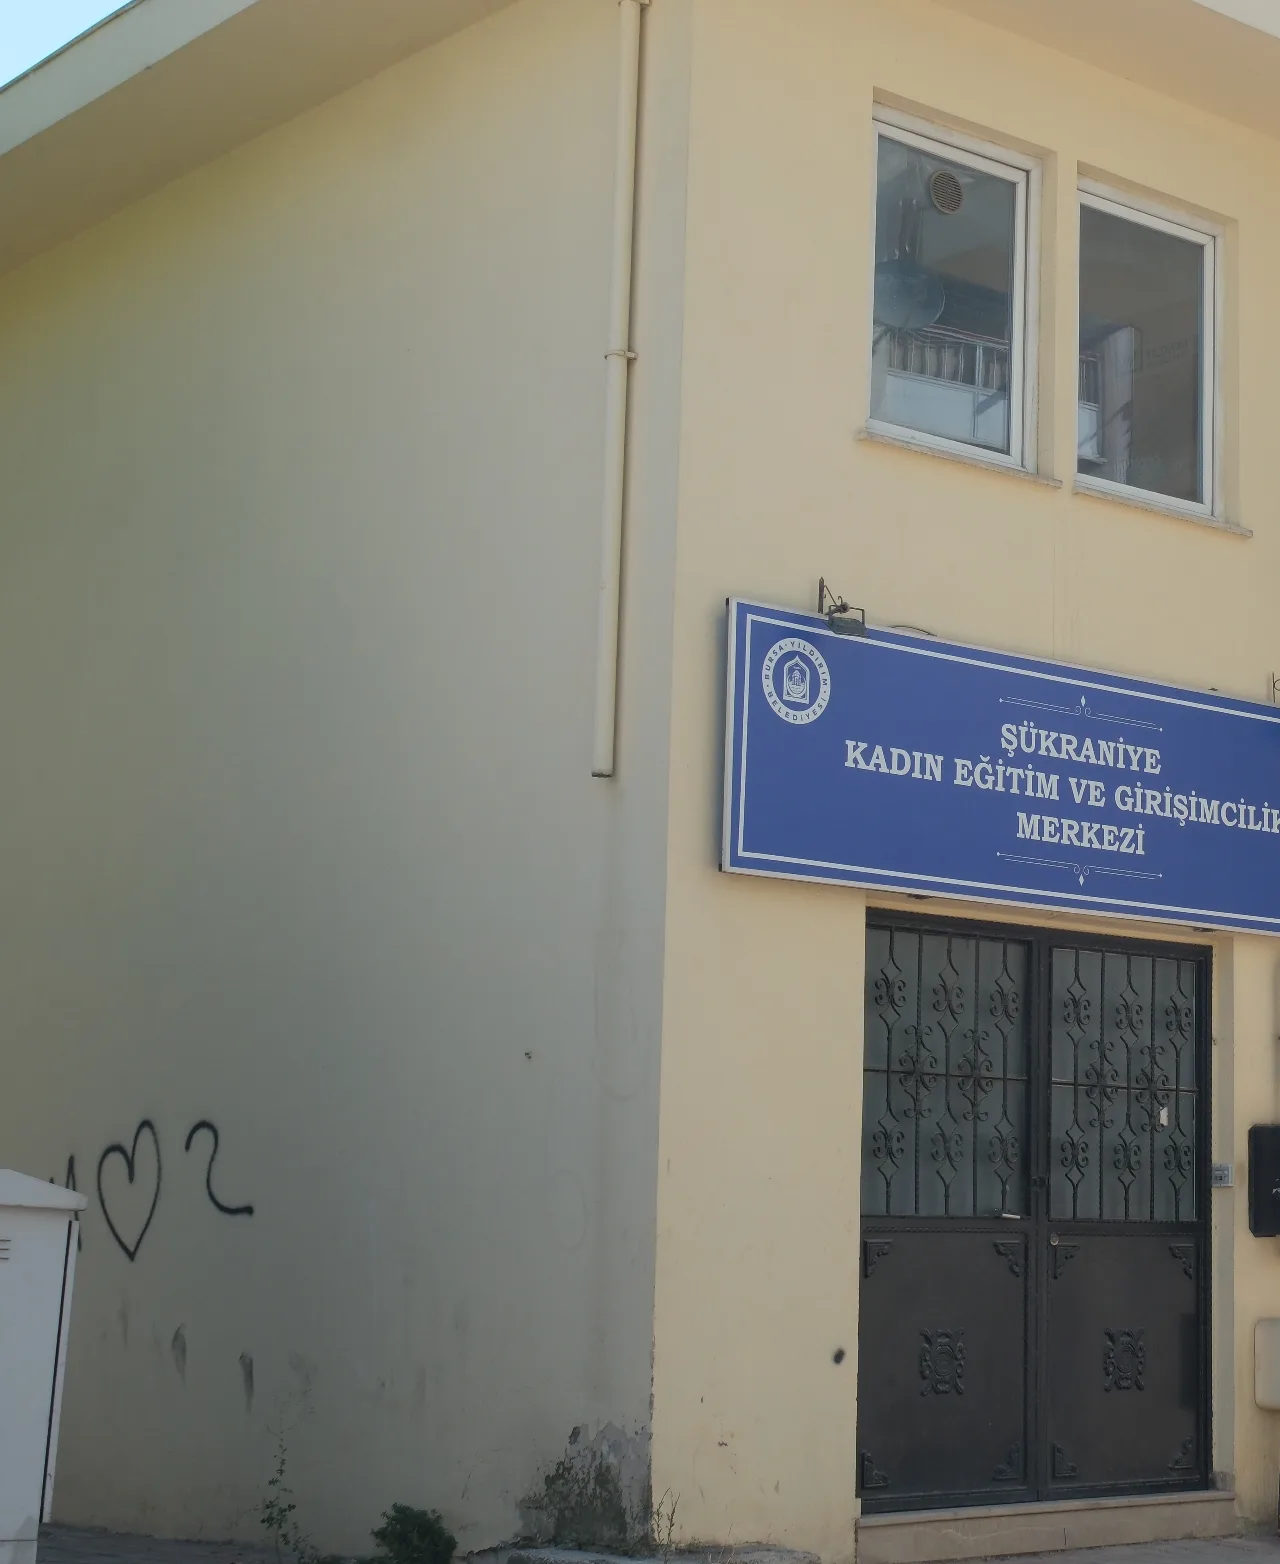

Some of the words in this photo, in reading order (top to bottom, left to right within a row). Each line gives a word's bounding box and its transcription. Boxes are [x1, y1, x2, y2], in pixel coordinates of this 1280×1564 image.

[765, 645, 784, 680] BURSA
[789, 641, 828, 686] YILDIRIM
[1000, 721, 1162, 775] ŞÜKRANİYE
[844, 739, 944, 782] KADIN
[953, 754, 1060, 801] EĞİTİM
[1068, 776, 1107, 807] VE
[1016, 811, 1146, 856] MERKEZİ
